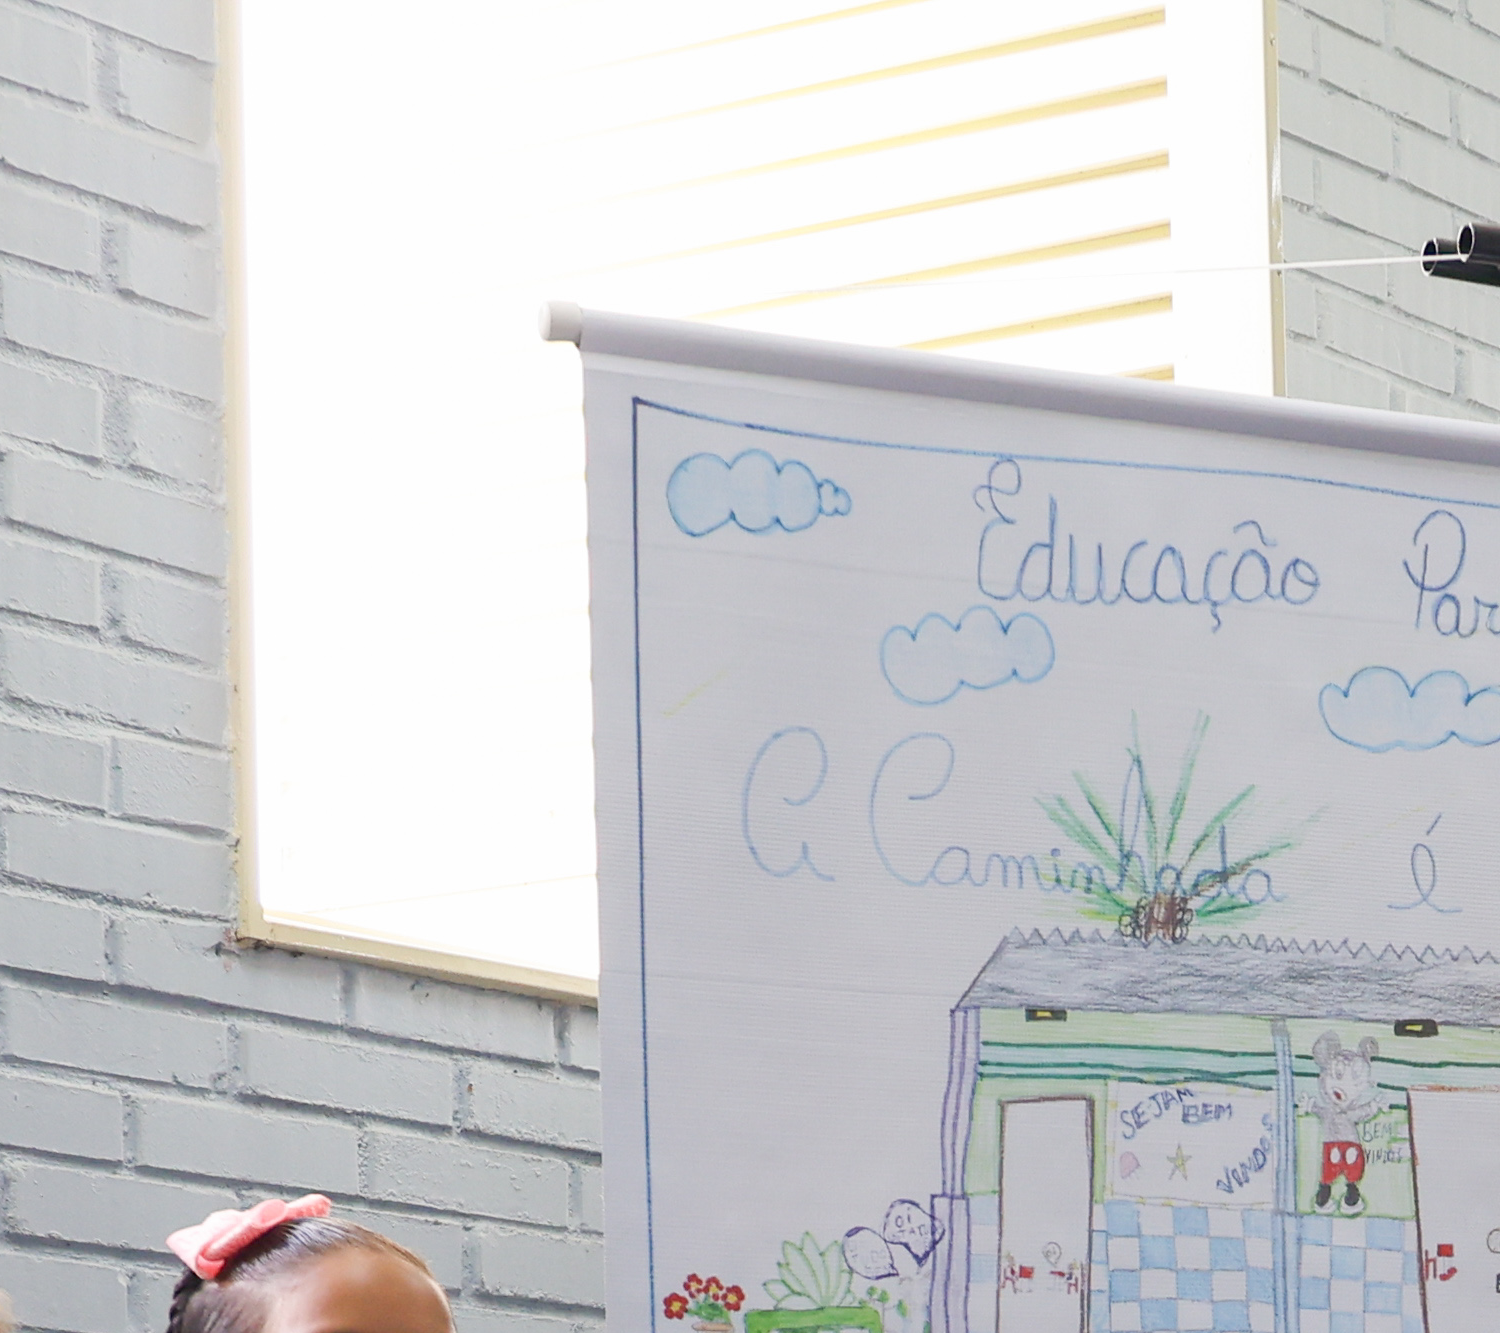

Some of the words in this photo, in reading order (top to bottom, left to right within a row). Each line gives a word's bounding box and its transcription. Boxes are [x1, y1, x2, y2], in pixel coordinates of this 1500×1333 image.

[973, 459, 1321, 633] Educação
[869, 731, 1289, 905] Caminhada
[1387, 813, 1463, 914] é
